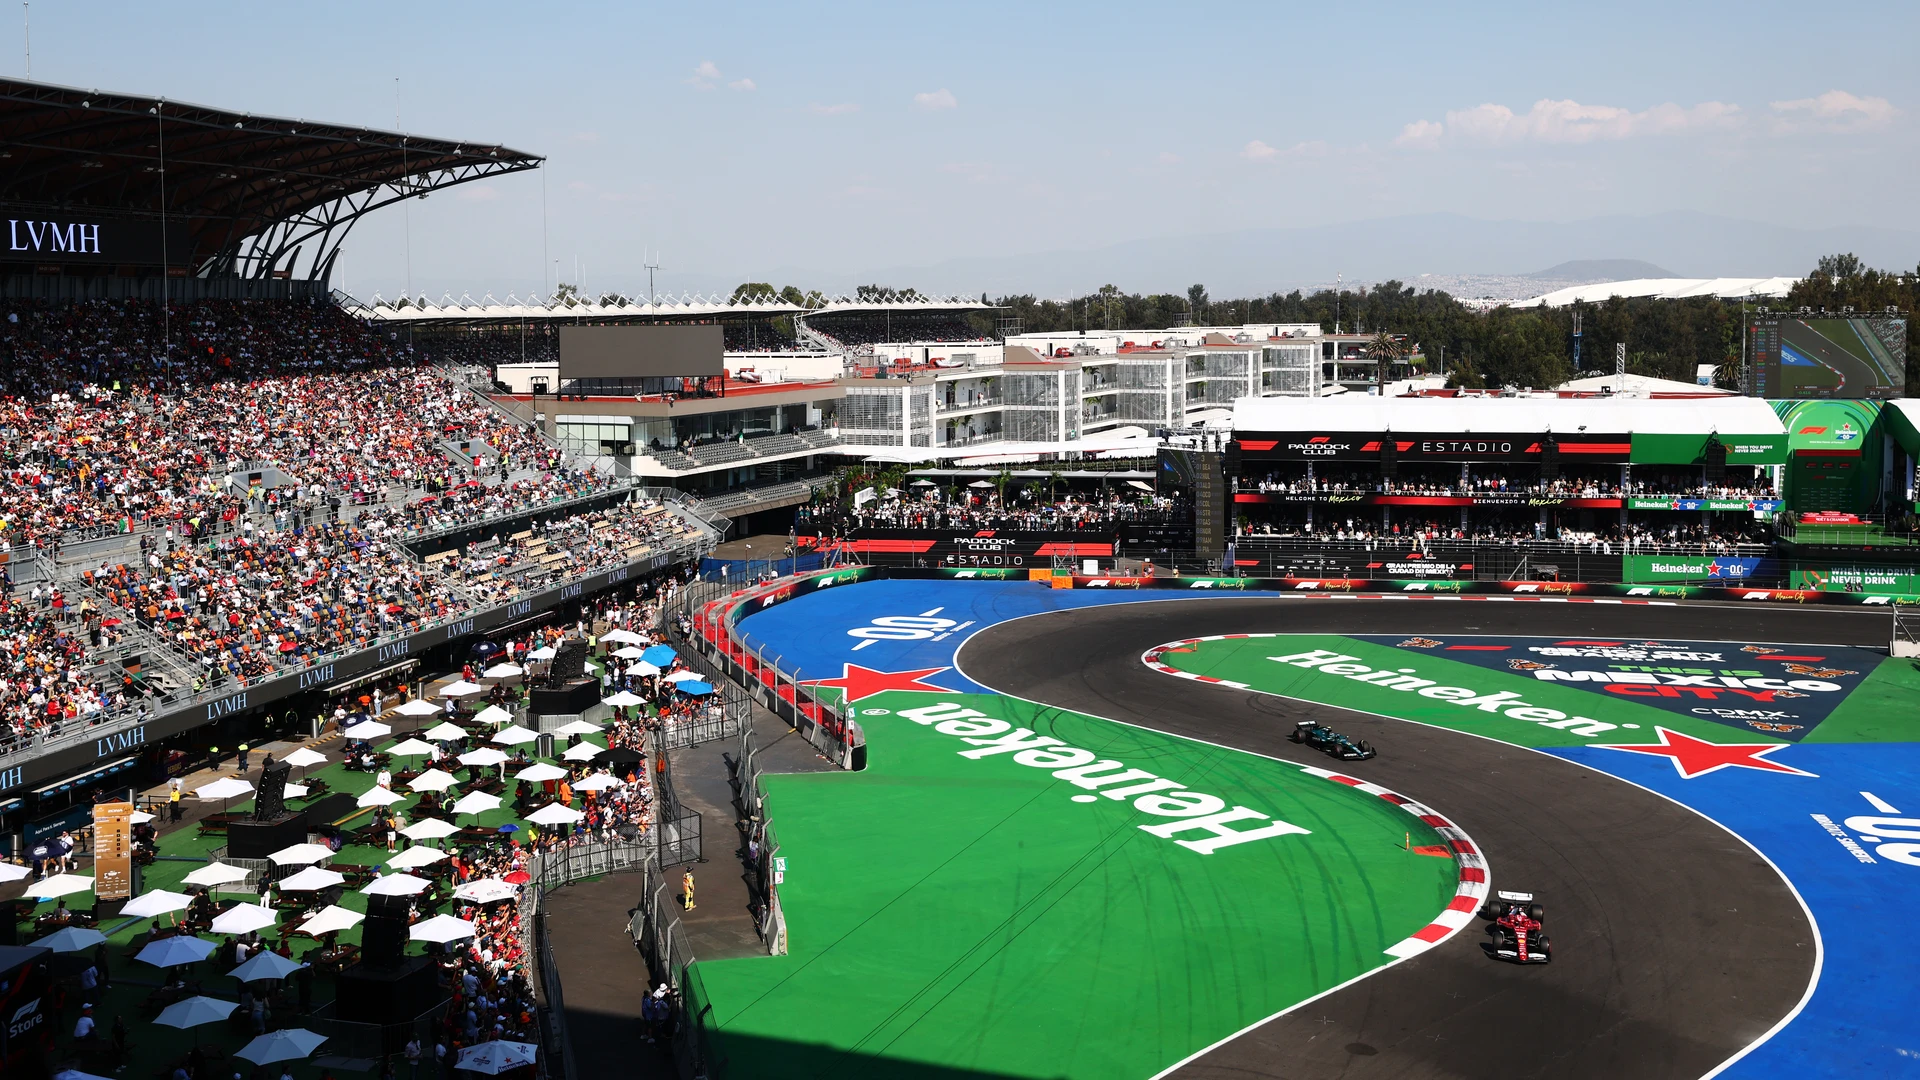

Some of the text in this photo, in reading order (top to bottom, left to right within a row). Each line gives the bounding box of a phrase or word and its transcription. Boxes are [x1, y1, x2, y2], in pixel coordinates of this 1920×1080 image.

[9, 219, 100, 254] LVMH
[1422, 442, 1512, 453] ESTADIO
[1328, 495, 1363, 504] Mexico
[1528, 498, 1564, 507] Mexico
[1710, 501, 1744, 509] Heineken
[954, 537, 1016, 545] PADDOCK
[651, 553, 669, 568] LVMH
[947, 555, 1023, 566] ESTADIO
[981, 568, 1006, 580] Mexico City
[1651, 563, 1703, 573] Heineken
[1831, 567, 1916, 576] WHEN YOU DRIVE
[609, 568, 628, 583] LVMH
[837, 570, 859, 583] Mexico City
[1831, 576, 1896, 585] NEVER DRINK
[1115, 577, 1141, 590] Mexico City
[1219, 578, 1245, 591] Mexico City
[1342, 580, 1352, 593] City
[1451, 581, 1461, 593] City
[1543, 582, 1573, 595] Mexico City
[561, 582, 582, 600] LVMH
[1658, 587, 1687, 600] Mexico City
[1775, 590, 1805, 604] Mexico City
[1895, 596, 1914, 605] Mexico
[508, 600, 531, 618] LVMH
[447, 619, 474, 638] LVMH
[379, 639, 409, 662] LVMH
[300, 664, 334, 689] LVMH
[1608, 664, 1764, 678] THIS IS
[1533, 669, 1842, 692] MEXICO
[1266, 649, 1618, 737] Heineken
[1603, 684, 1777, 702] CITY
[207, 693, 247, 720] LVMH
[97, 726, 145, 757] LVMH
[896, 702, 1312, 855] Heineken
[10, 1013, 43, 1039] Store
